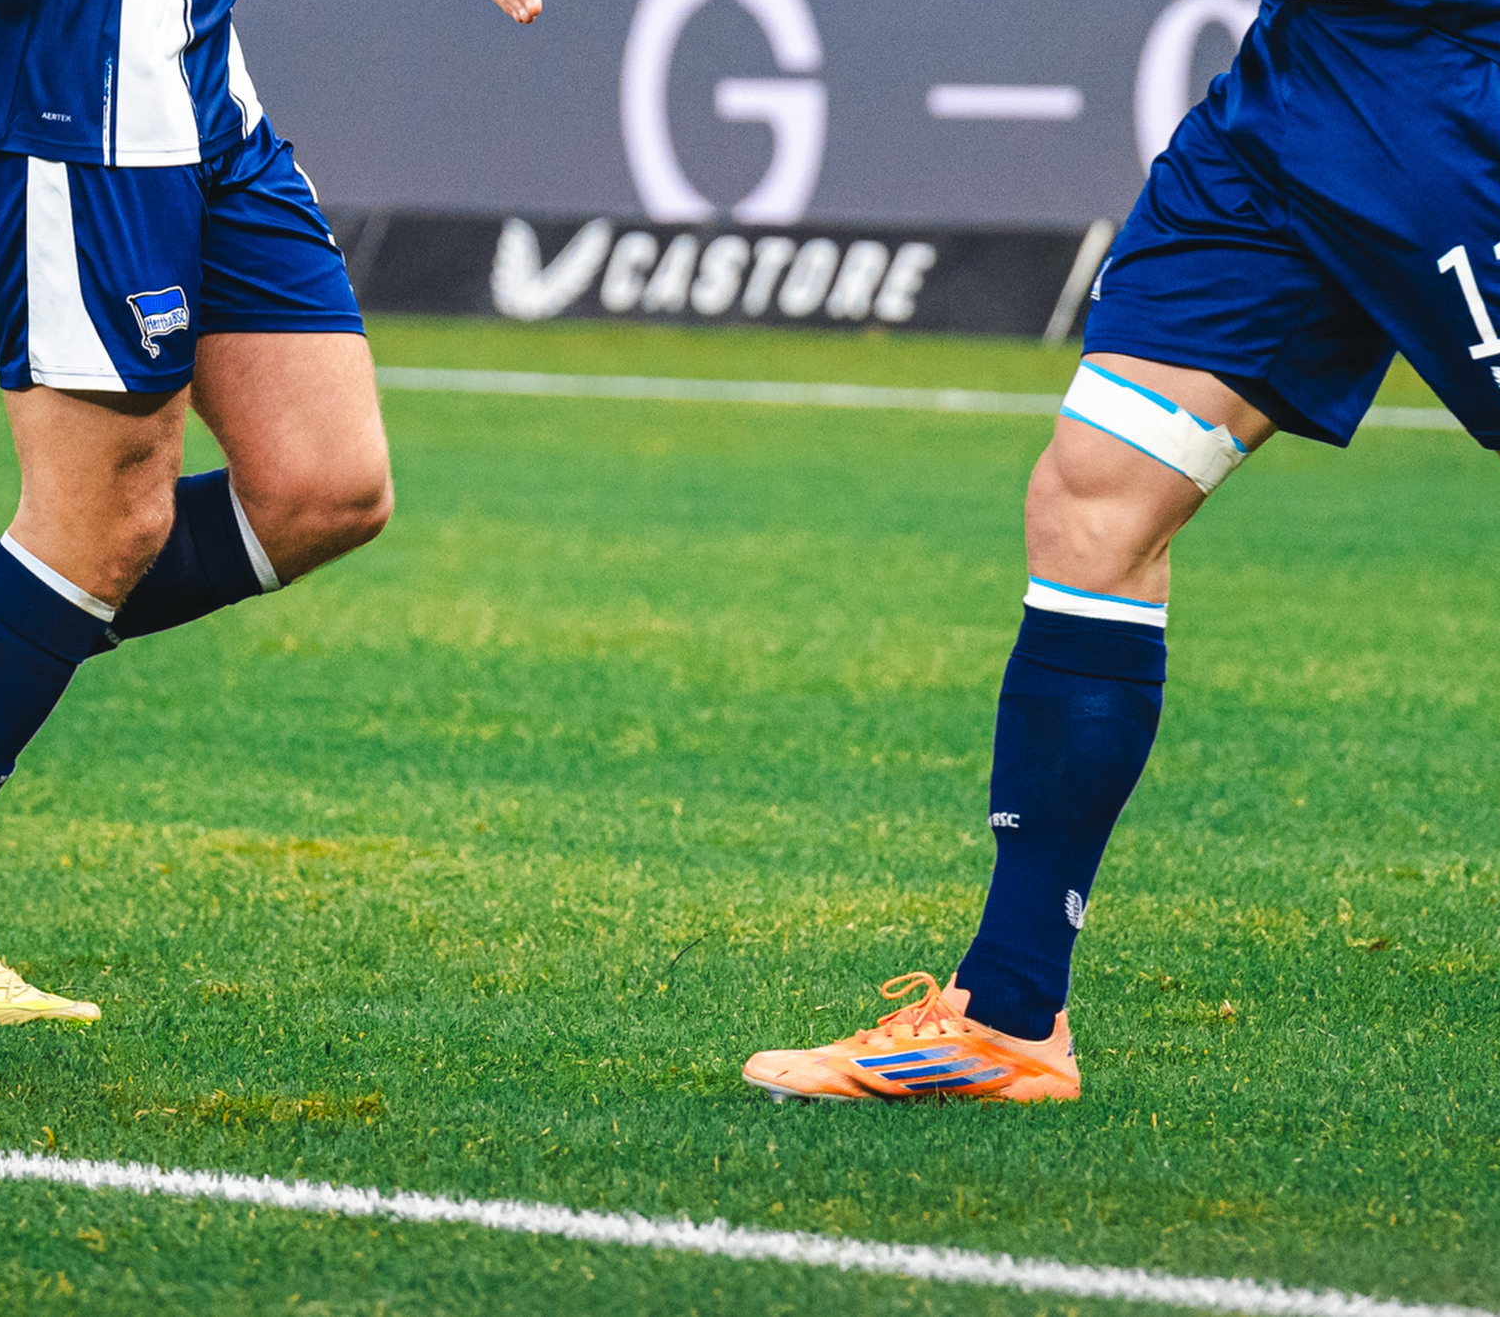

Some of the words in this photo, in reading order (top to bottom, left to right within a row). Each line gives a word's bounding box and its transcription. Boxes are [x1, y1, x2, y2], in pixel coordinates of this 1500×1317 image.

[601, 231, 938, 324] CASTORE
[146, 315, 172, 332] Hertha
[171, 309, 186, 324] BSC
